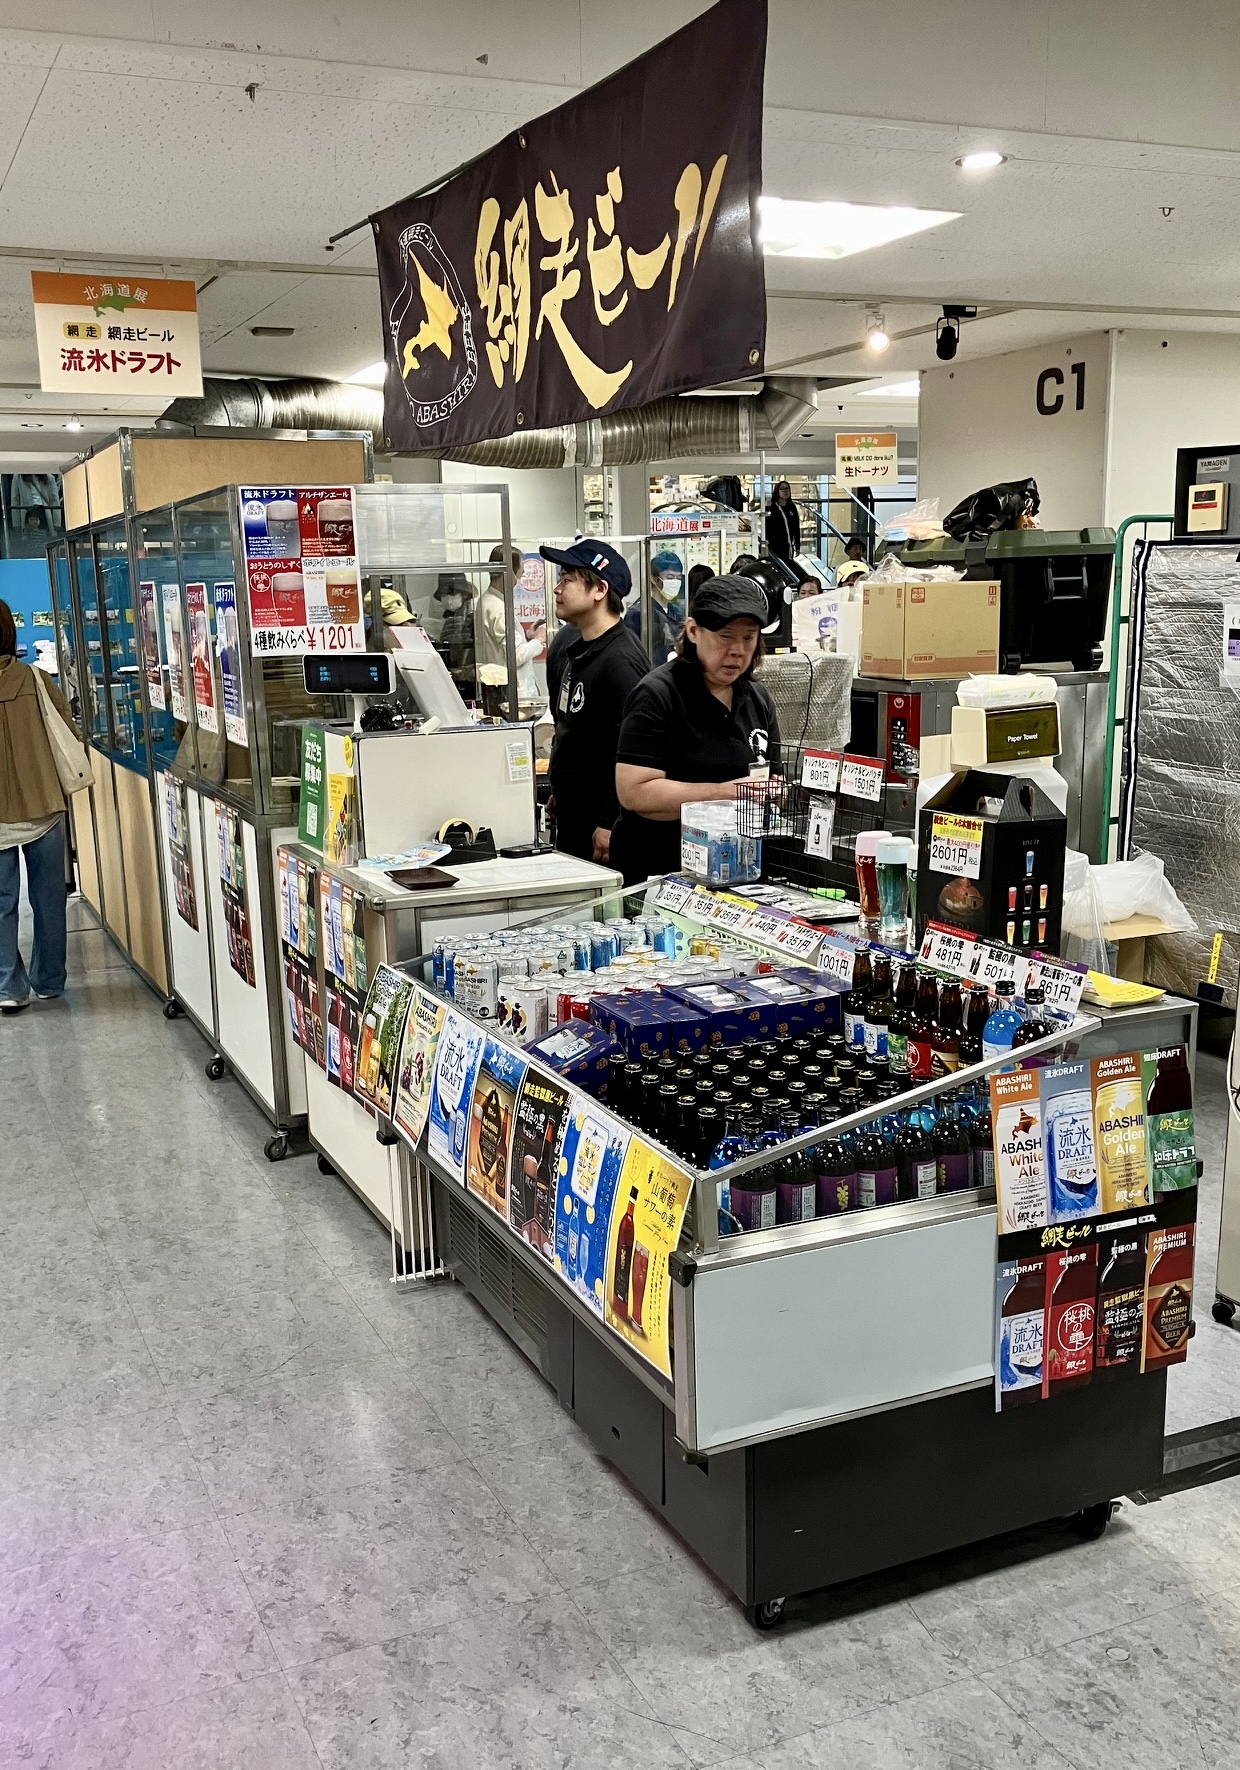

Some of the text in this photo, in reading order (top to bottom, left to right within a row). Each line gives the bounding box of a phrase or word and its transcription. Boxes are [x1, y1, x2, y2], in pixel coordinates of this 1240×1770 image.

[474, 154, 728, 409] 網走ビール
[83, 283, 149, 304] 北海道展
[67, 324, 175, 342] 網走 網走ビール
[60, 348, 182, 375] 流氷ドラフト
[1036, 362, 1086, 416] C1
[1200, 459, 1228, 467] YAMAGEN
[845, 466, 888, 477] 生ドーナツ
[244, 490, 349, 500] 流氷ドラフト アルチザンエール
[651, 517, 699, 532] 北海道展
[250, 558, 355, 570] おうとうのしずく ホワイトエール
[254, 626, 354, 651] 4種飲みくらべ ¥1201
[1023, 733, 1038, 741] Towel
[305, 739, 321, 763] 友だち
[305, 762, 321, 786] 募集中
[810, 770, 829, 783] 801円
[855, 777, 876, 793] 1501円
[932, 844, 968, 865] 2601円
[664, 891, 682, 905] 351円
[694, 899, 714, 915] 351円
[720, 908, 742, 924] 351円
[755, 920, 777, 935] 440円
[786, 935, 812, 951] 351円
[819, 953, 849, 977] 1001円
[935, 947, 963, 968] 481円
[376, 982, 395, 1001] Golden
[1038, 979, 1072, 1002] 861円
[378, 996, 389, 1009] Ale
[415, 1006, 437, 1028] ABASHIRI
[444, 1039, 466, 1074] 流氷
[1099, 1057, 1133, 1070] ABASHIRI
[440, 1062, 463, 1092] DRAFT
[1097, 1064, 1137, 1078] Golden Ale
[996, 1073, 1032, 1087] ABASHIRI
[996, 1083, 1033, 1095] White Ale
[1059, 1124, 1091, 1148] 流氷
[1103, 1129, 1145, 1146] Golden
[1001, 1137, 1042, 1154] ABASH
[1058, 1144, 1093, 1160] DRAFT
[1115, 1142, 1137, 1157] Ale
[1009, 1152, 1044, 1167] White
[1018, 1165, 1040, 1178] Ale
[651, 1182, 676, 1210] 山葡萄
[643, 1197, 676, 1231] サワーの素
[1017, 1210, 1045, 1224] 網走ビール
[1040, 1224, 1093, 1248] 網走ビール
[1152, 1231, 1187, 1245] ABASHIRI
[1152, 1238, 1187, 1252] PREMIUM
[1002, 1262, 1043, 1277] 流氷DRAFT
[1160, 1305, 1188, 1318] ABASHIRI
[1160, 1313, 1187, 1325] PREMIUM
[1063, 1306, 1092, 1334] 桜桃
[1072, 1322, 1083, 1332] の
[1014, 1323, 1042, 1344] 流氷
[1165, 1329, 1181, 1339] BEER
[1012, 1338, 1043, 1354] DRAFT
